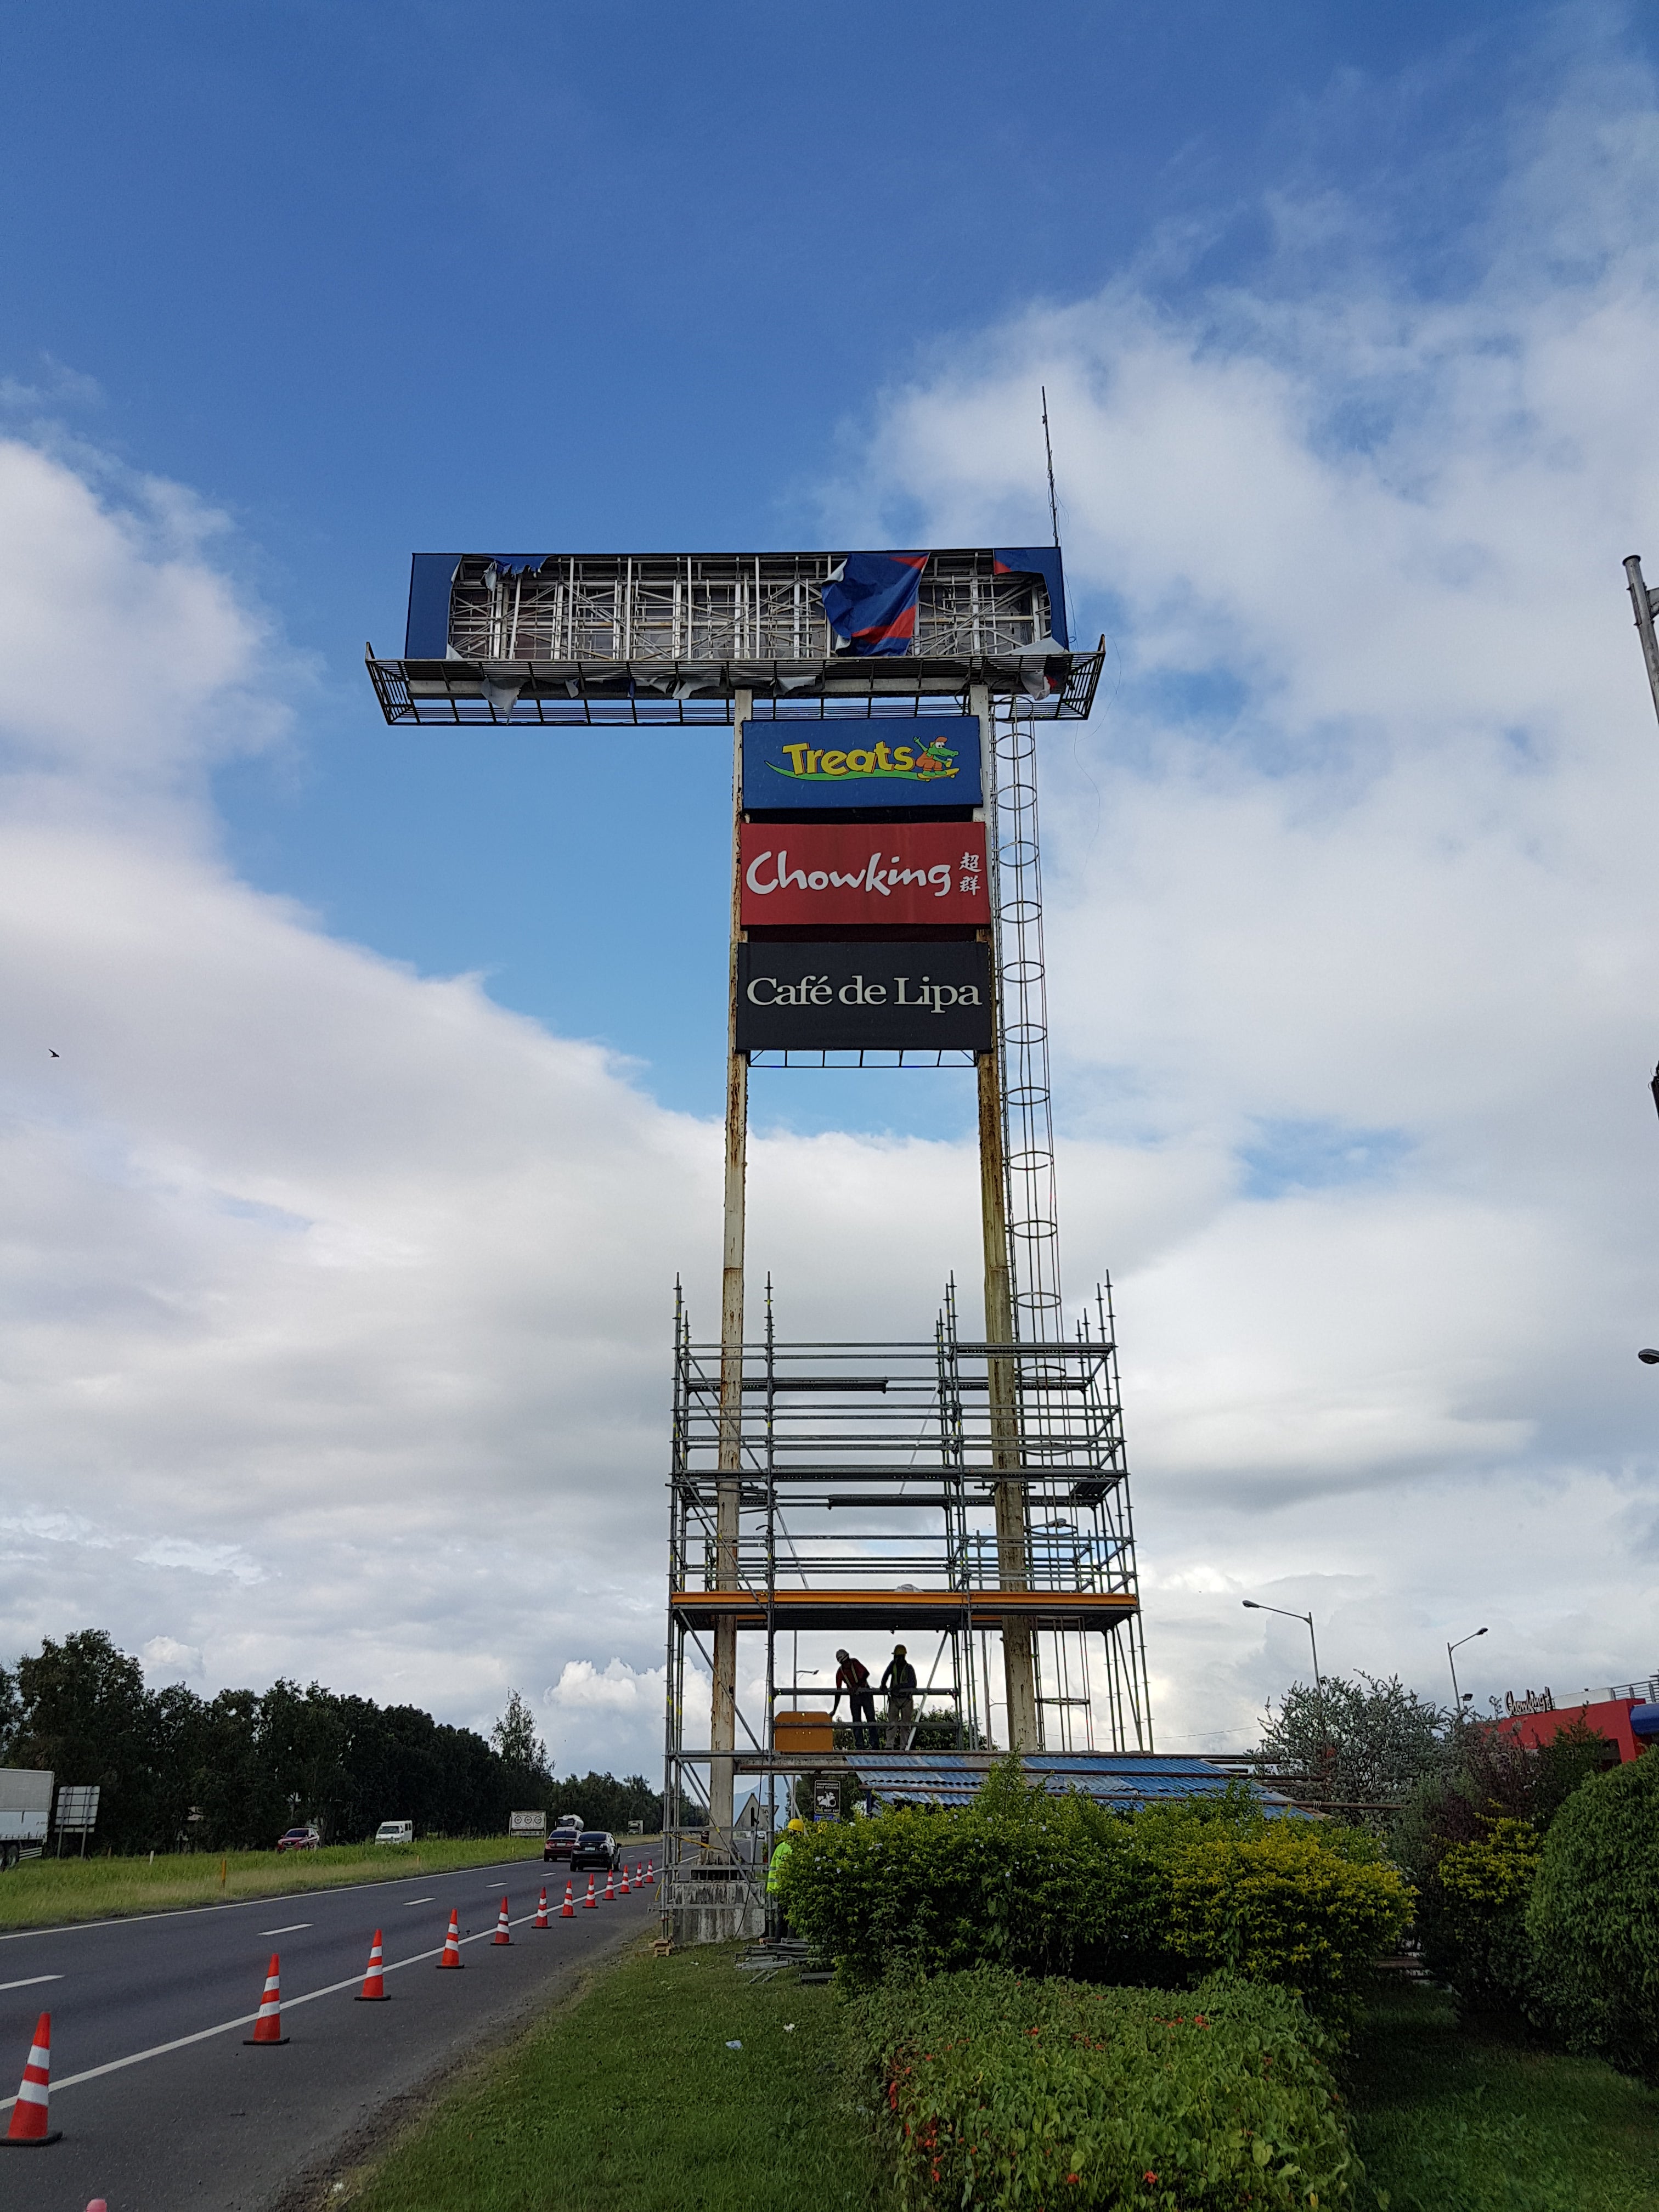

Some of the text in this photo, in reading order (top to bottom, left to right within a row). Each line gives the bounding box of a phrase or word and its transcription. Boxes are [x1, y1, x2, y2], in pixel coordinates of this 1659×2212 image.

[782, 741, 915, 775] Treats
[746, 850, 951, 896] Chowking
[958, 851, 982, 896] 超群
[747, 975, 982, 1013] Café de Lipa
